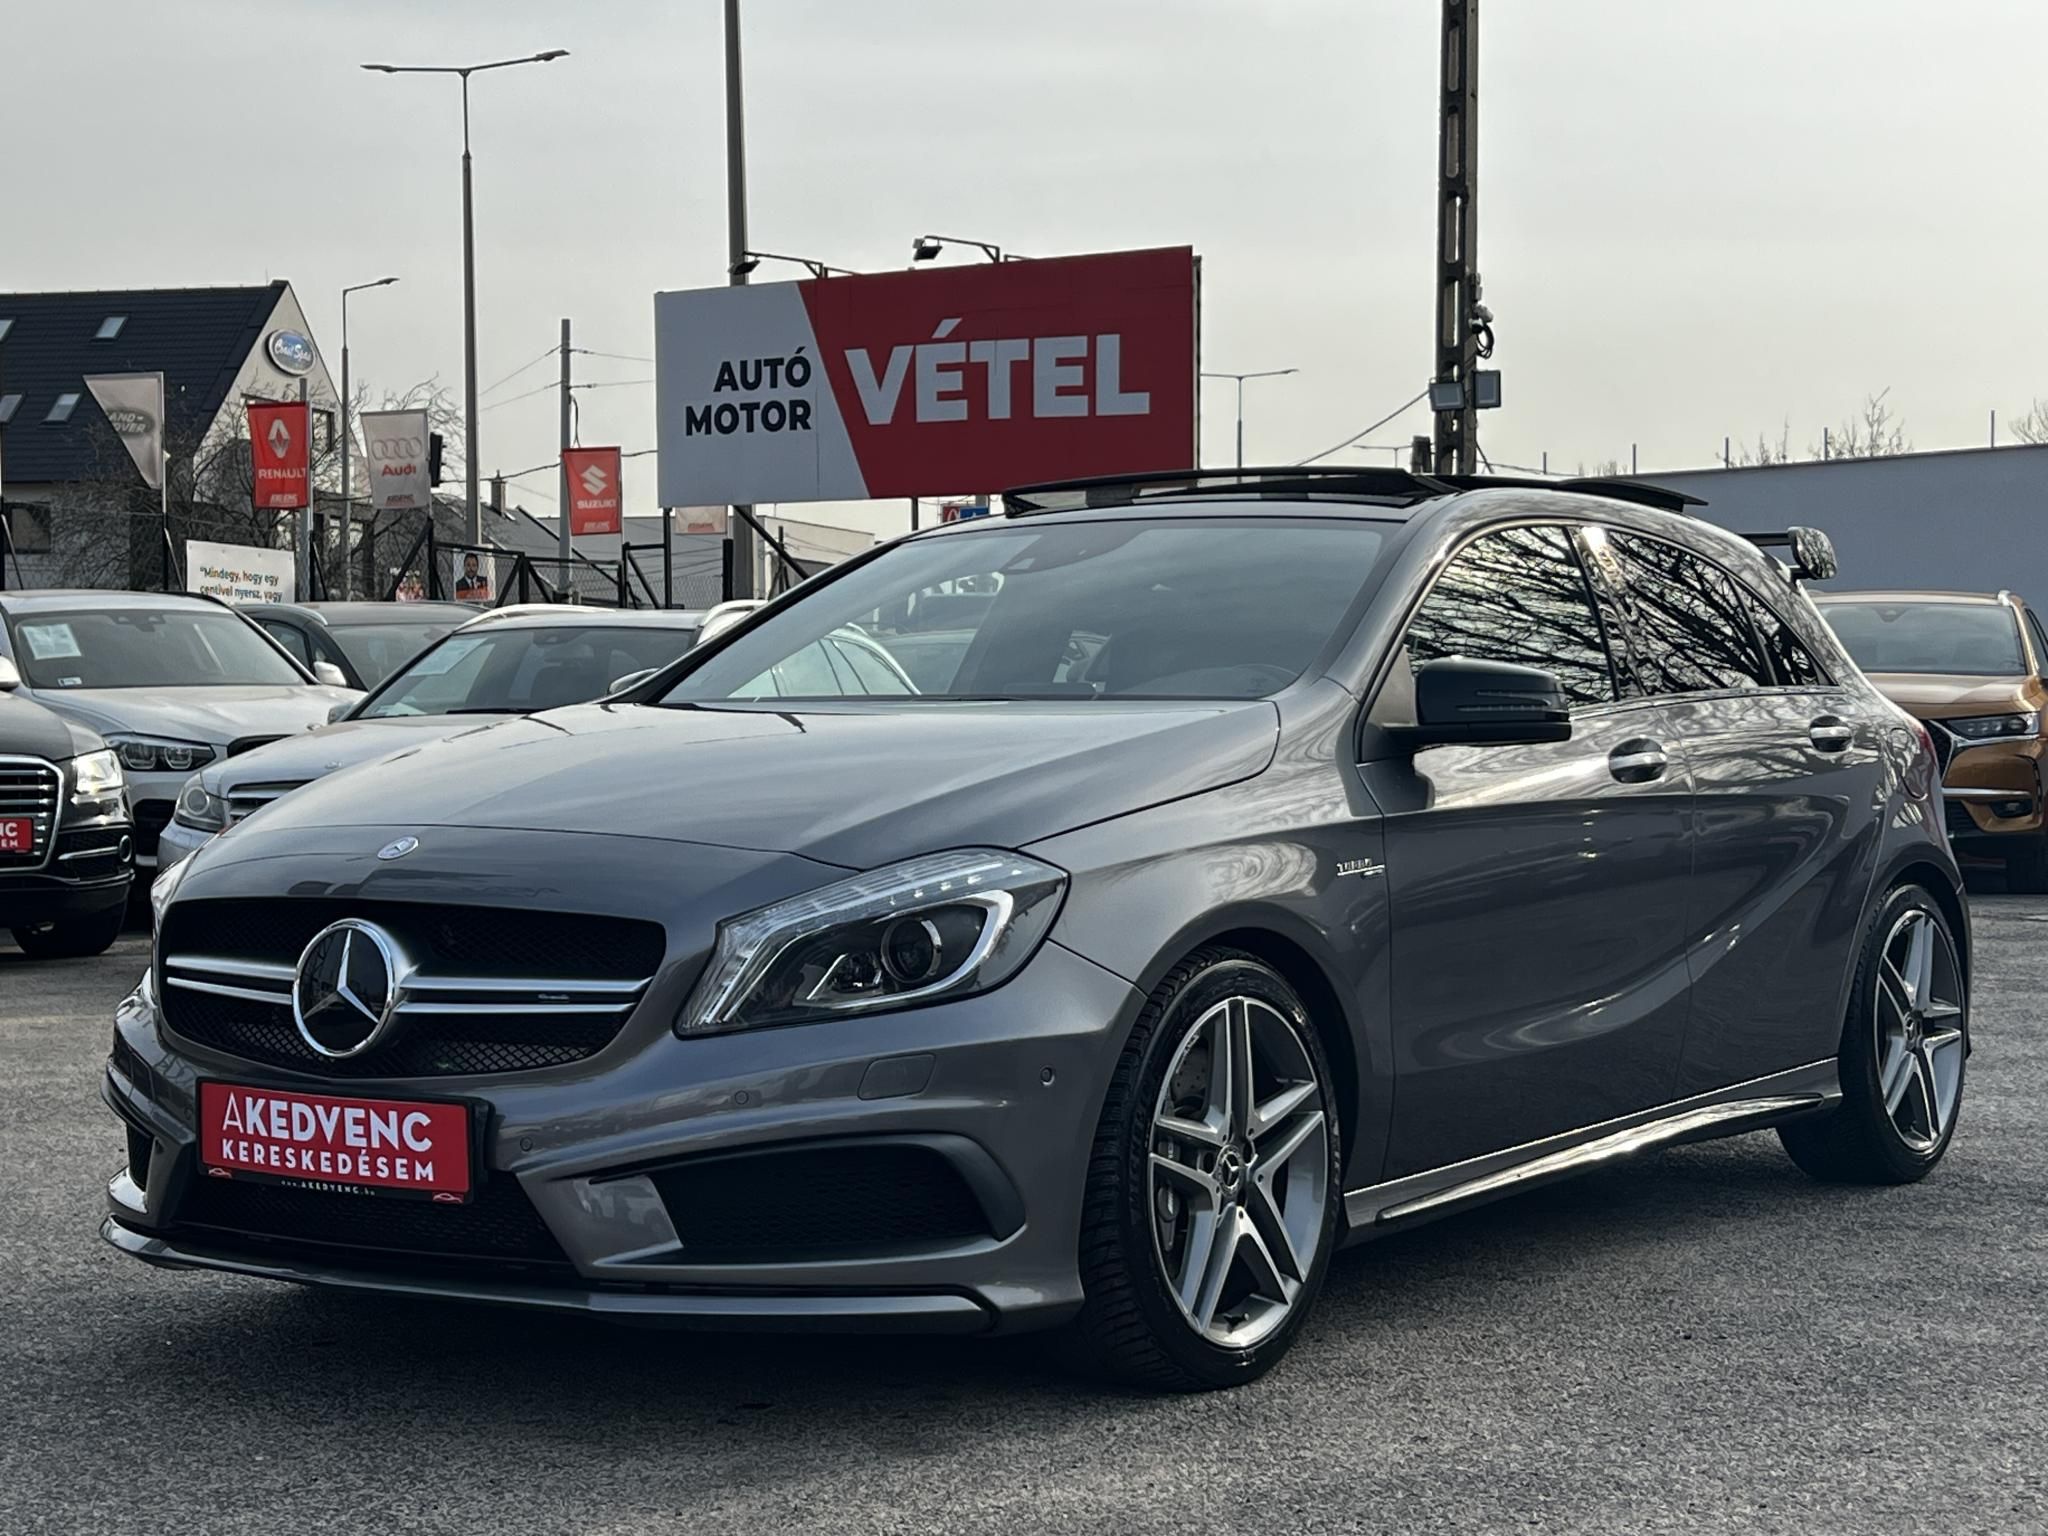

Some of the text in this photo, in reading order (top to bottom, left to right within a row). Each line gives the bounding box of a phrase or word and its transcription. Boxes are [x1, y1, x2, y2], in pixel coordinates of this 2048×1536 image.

[713, 346, 812, 392] AUTÓ
[844, 318, 1150, 425] VÉTEL
[108, 411, 136, 422] AND
[685, 399, 812, 437] MOTOR
[258, 467, 306, 480] RENAULT
[382, 463, 417, 477] Audi
[577, 499, 617, 510] SUZUKI
[243, 570, 263, 585] hogy
[264, 574, 279, 587] egy
[264, 591, 284, 603] vagy
[222, 1138, 435, 1182] KERESKEDÉSEM
